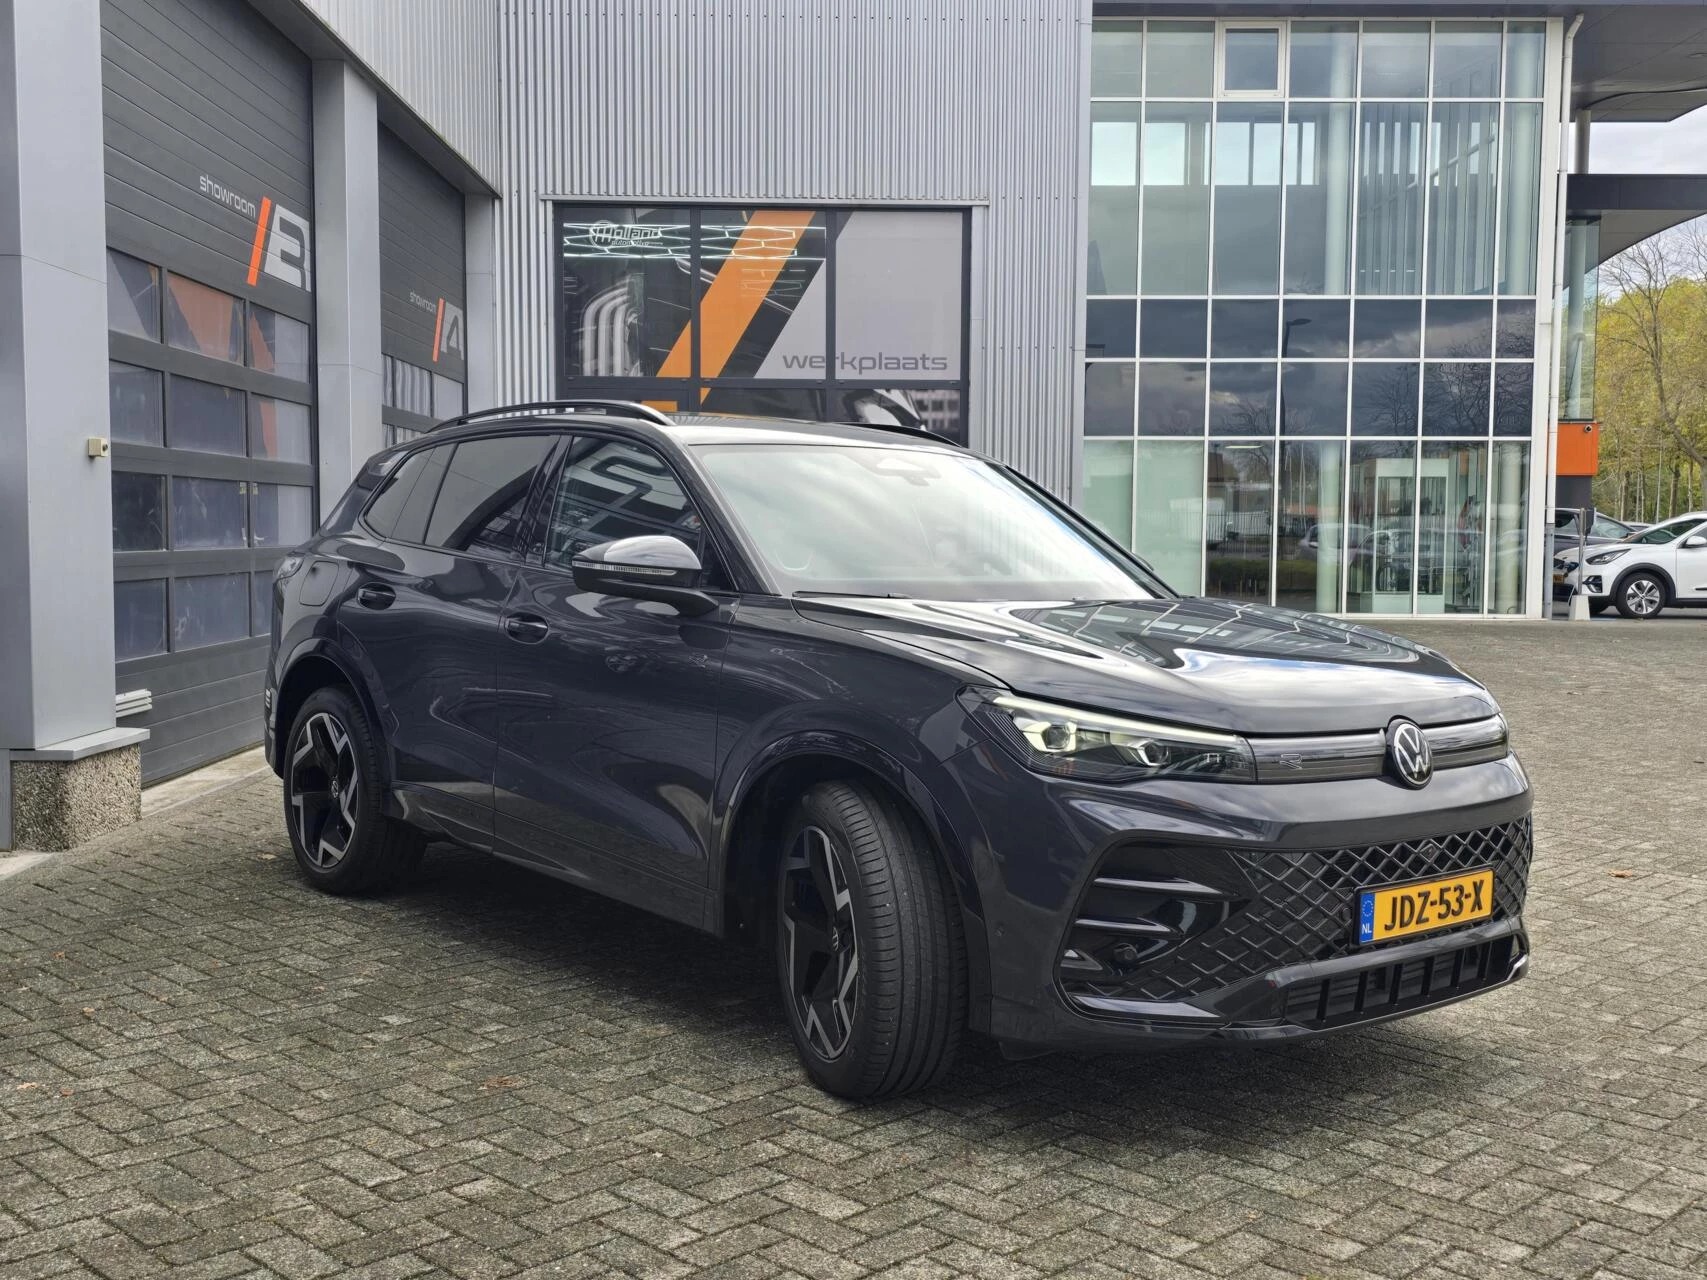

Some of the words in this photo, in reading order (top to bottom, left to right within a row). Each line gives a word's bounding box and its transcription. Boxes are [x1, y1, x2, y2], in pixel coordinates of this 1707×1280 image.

[200, 174, 256, 218] showroom
[264, 203, 312, 293] B
[440, 301, 465, 361] A
[1361, 923, 1372, 934] NL
[1384, 879, 1485, 931] JDZ-53-X
